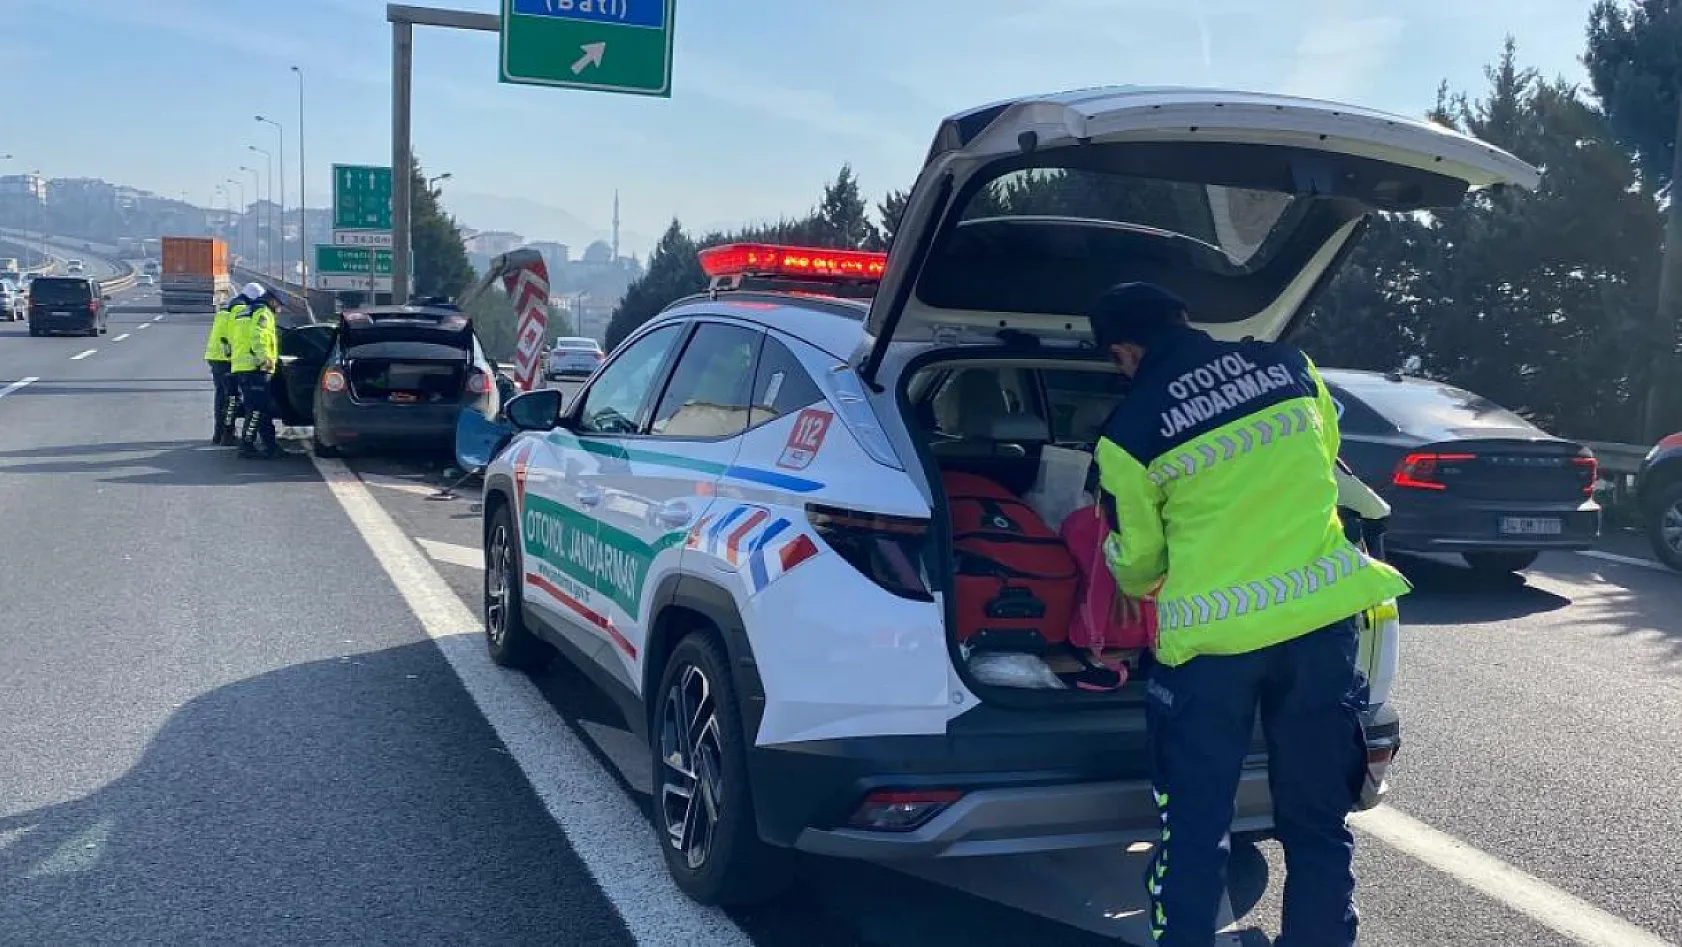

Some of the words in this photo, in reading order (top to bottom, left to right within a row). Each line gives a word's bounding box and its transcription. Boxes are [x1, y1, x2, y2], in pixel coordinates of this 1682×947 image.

[1159, 363, 1294, 437] JANDARMASI
[1168, 352, 1258, 400] OTOYOL
[793, 416, 824, 446] 112
